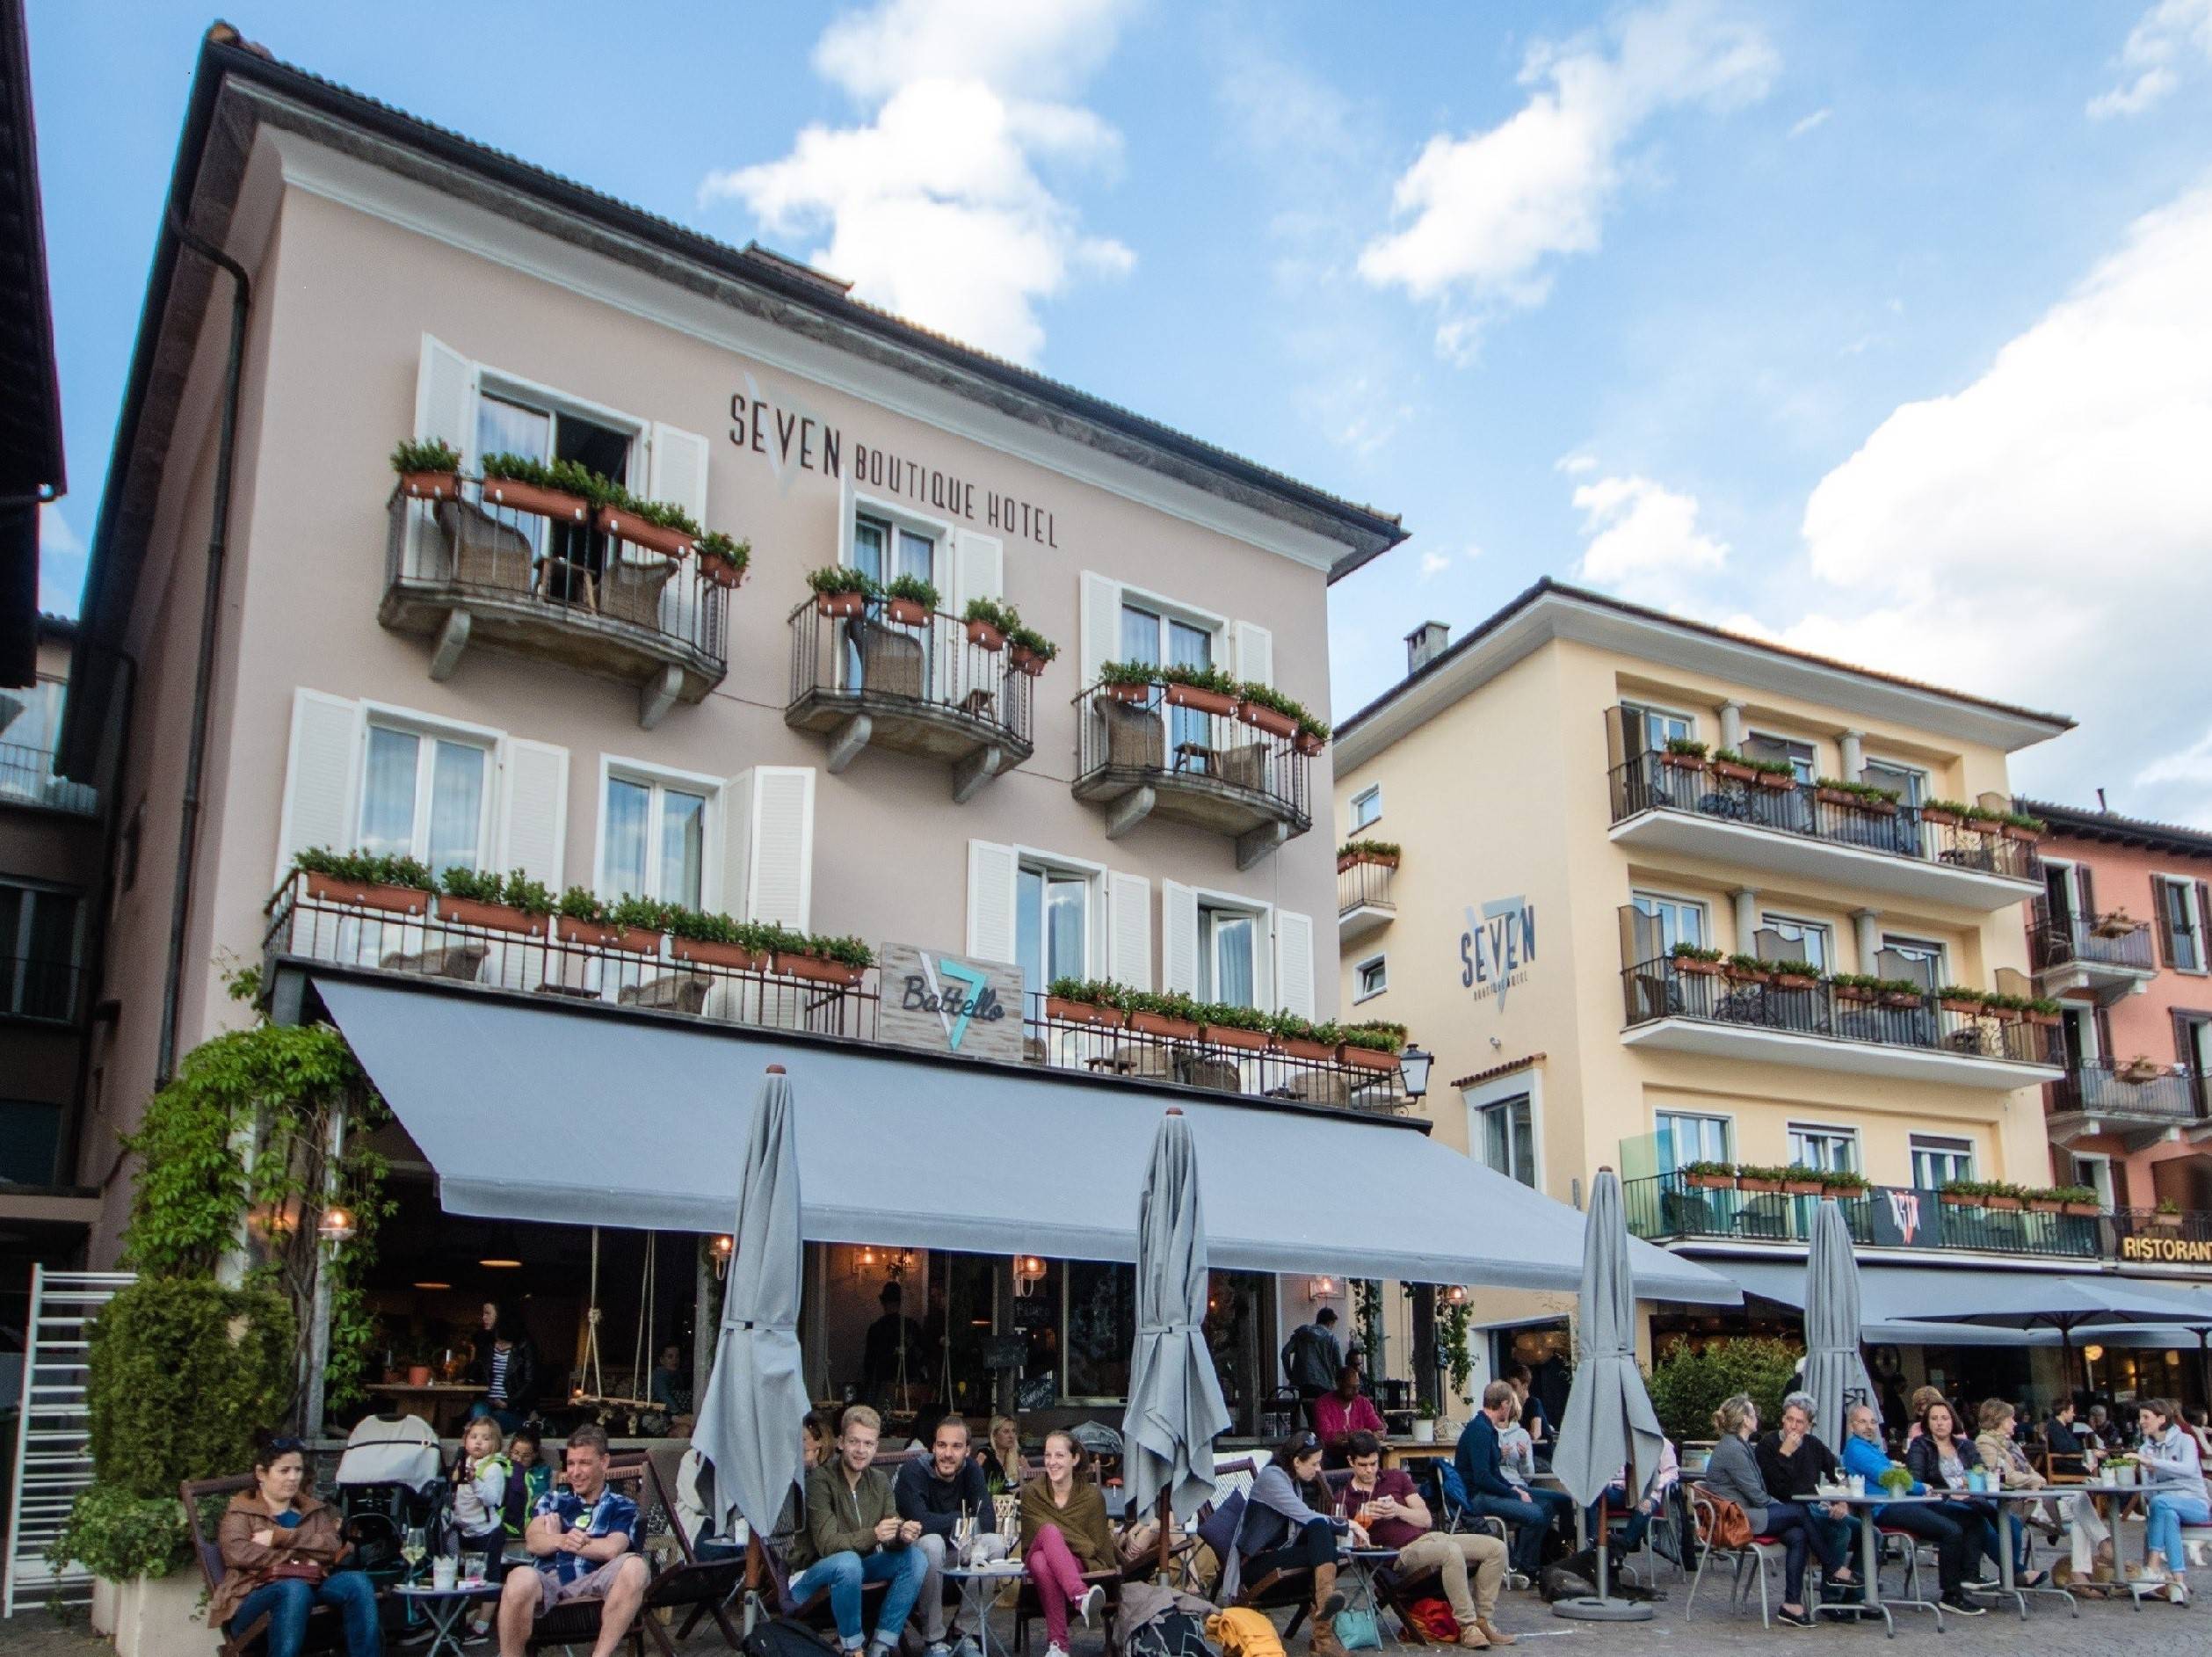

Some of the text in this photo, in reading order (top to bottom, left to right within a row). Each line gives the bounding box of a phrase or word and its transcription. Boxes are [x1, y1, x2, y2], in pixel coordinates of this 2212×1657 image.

[729, 392, 1058, 549] SEVEN BOUTIQUE HOTEL
[1461, 905, 1535, 988] SEVEN
[2122, 1237, 2212, 1261] RISTORAN
